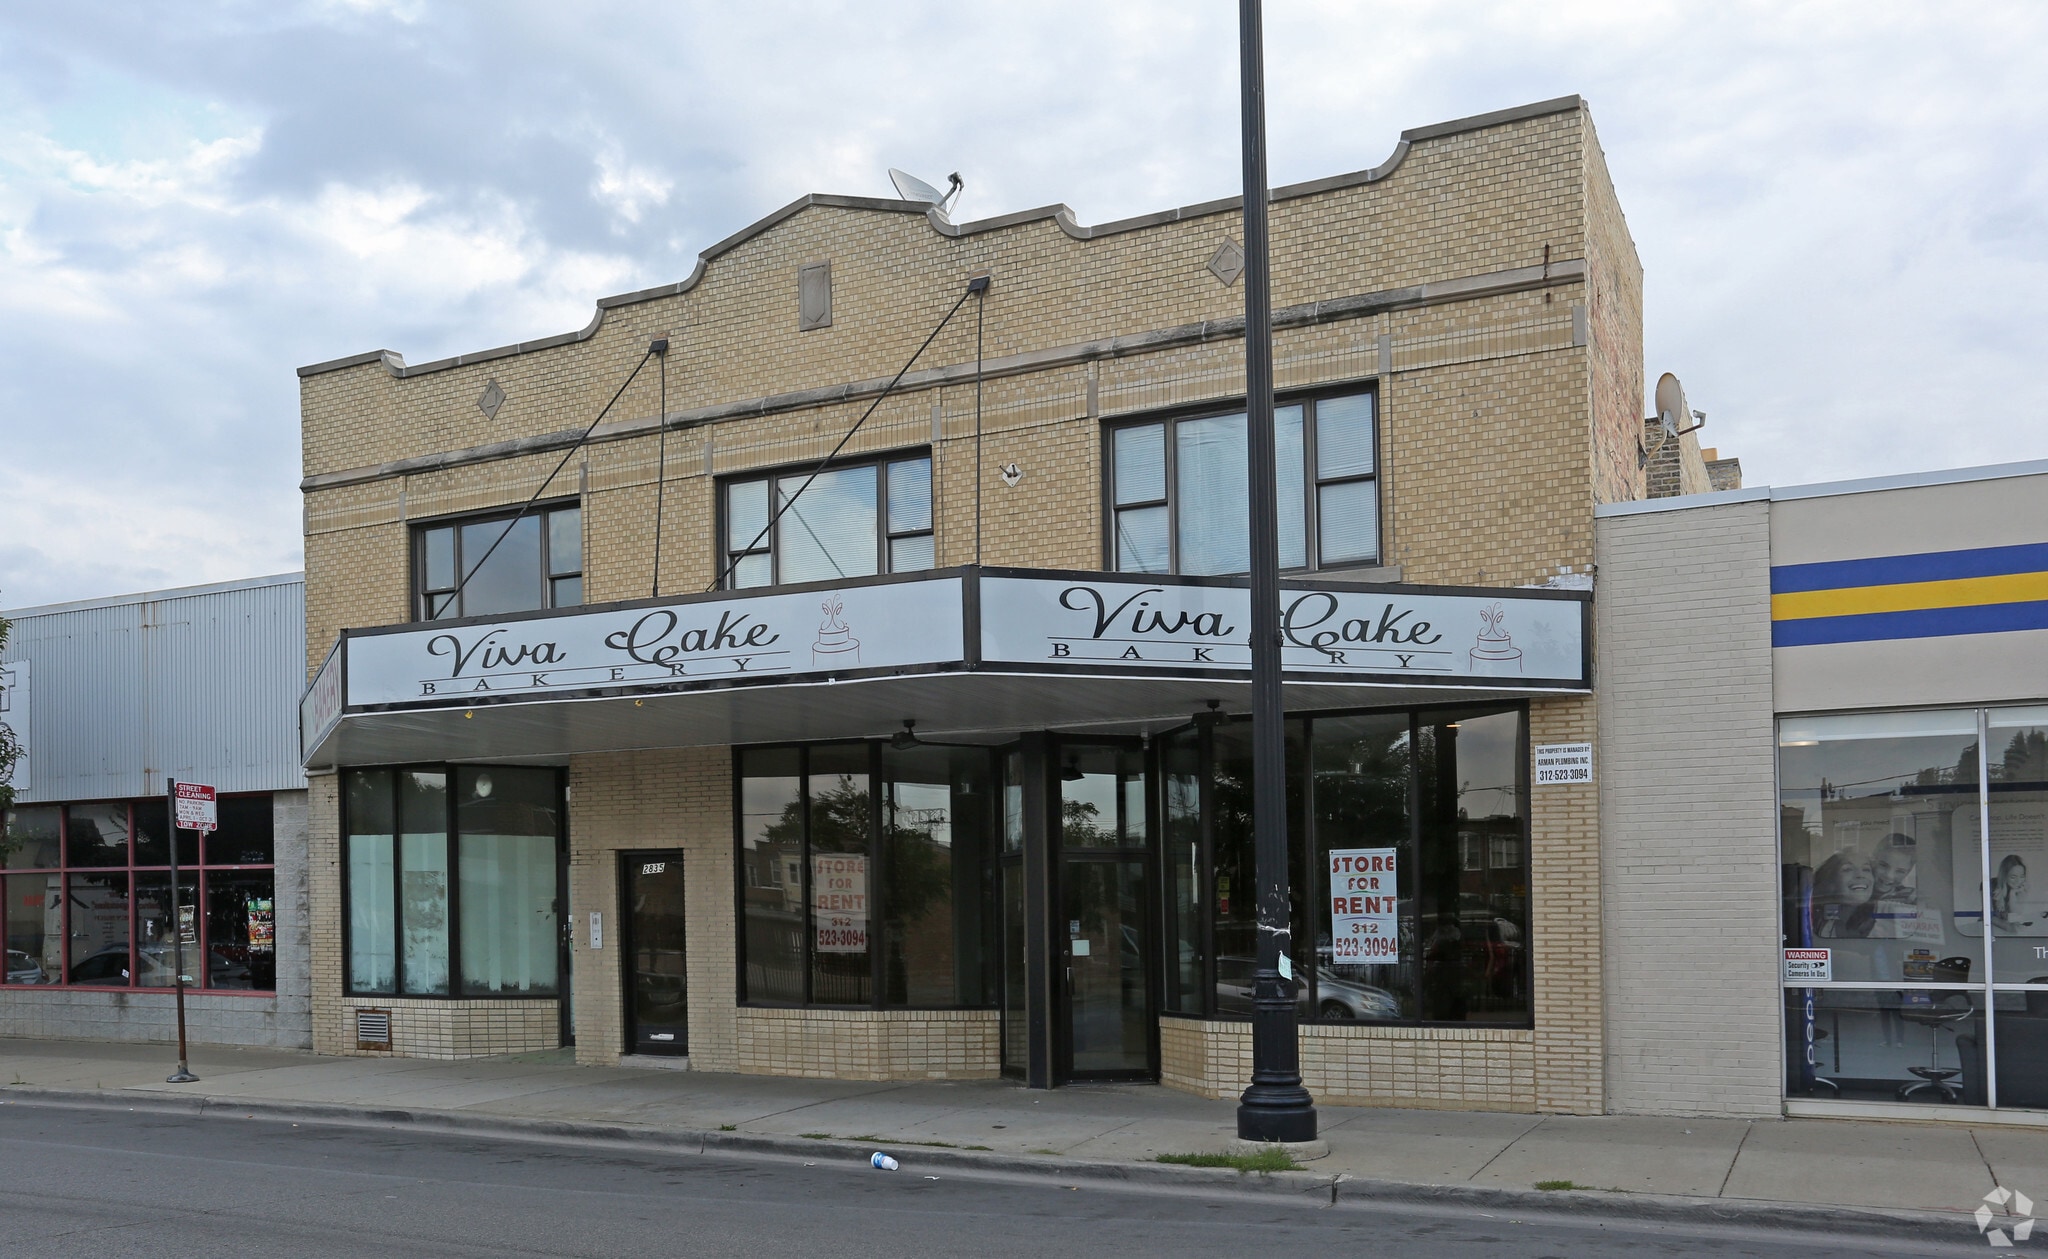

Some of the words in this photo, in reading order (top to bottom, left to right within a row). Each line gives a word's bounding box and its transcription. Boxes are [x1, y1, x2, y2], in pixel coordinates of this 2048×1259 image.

[1058, 586, 1235, 639] Viva
[1275, 592, 1443, 656] Cake
[426, 629, 567, 678] Viva
[604, 610, 781, 669] Cake
[1051, 642, 1416, 668] BAKRY
[421, 657, 753, 695] BAKERY
[1538, 758, 1555, 766] ARMAN
[1555, 757, 1579, 766] PLUMBING
[1539, 768, 1588, 781] 312-523-3094
[178, 791, 211, 800] CLEANING
[643, 863, 665, 874] 2835
[818, 860, 864, 874] STORE
[1332, 856, 1394, 873] STORE
[828, 878, 853, 889] FOR
[1347, 877, 1380, 891] FOR
[817, 894, 865, 911] RENT
[1333, 896, 1397, 915] RENT
[831, 917, 852, 927] 312
[1351, 923, 1379, 934] 312
[1335, 937, 1397, 957] 523-3094
[1787, 951, 1827, 959] WARNING
[1788, 961, 1810, 970] Security
[1788, 969, 1810, 977] Cameras
[1816, 970, 1826, 978] Use
